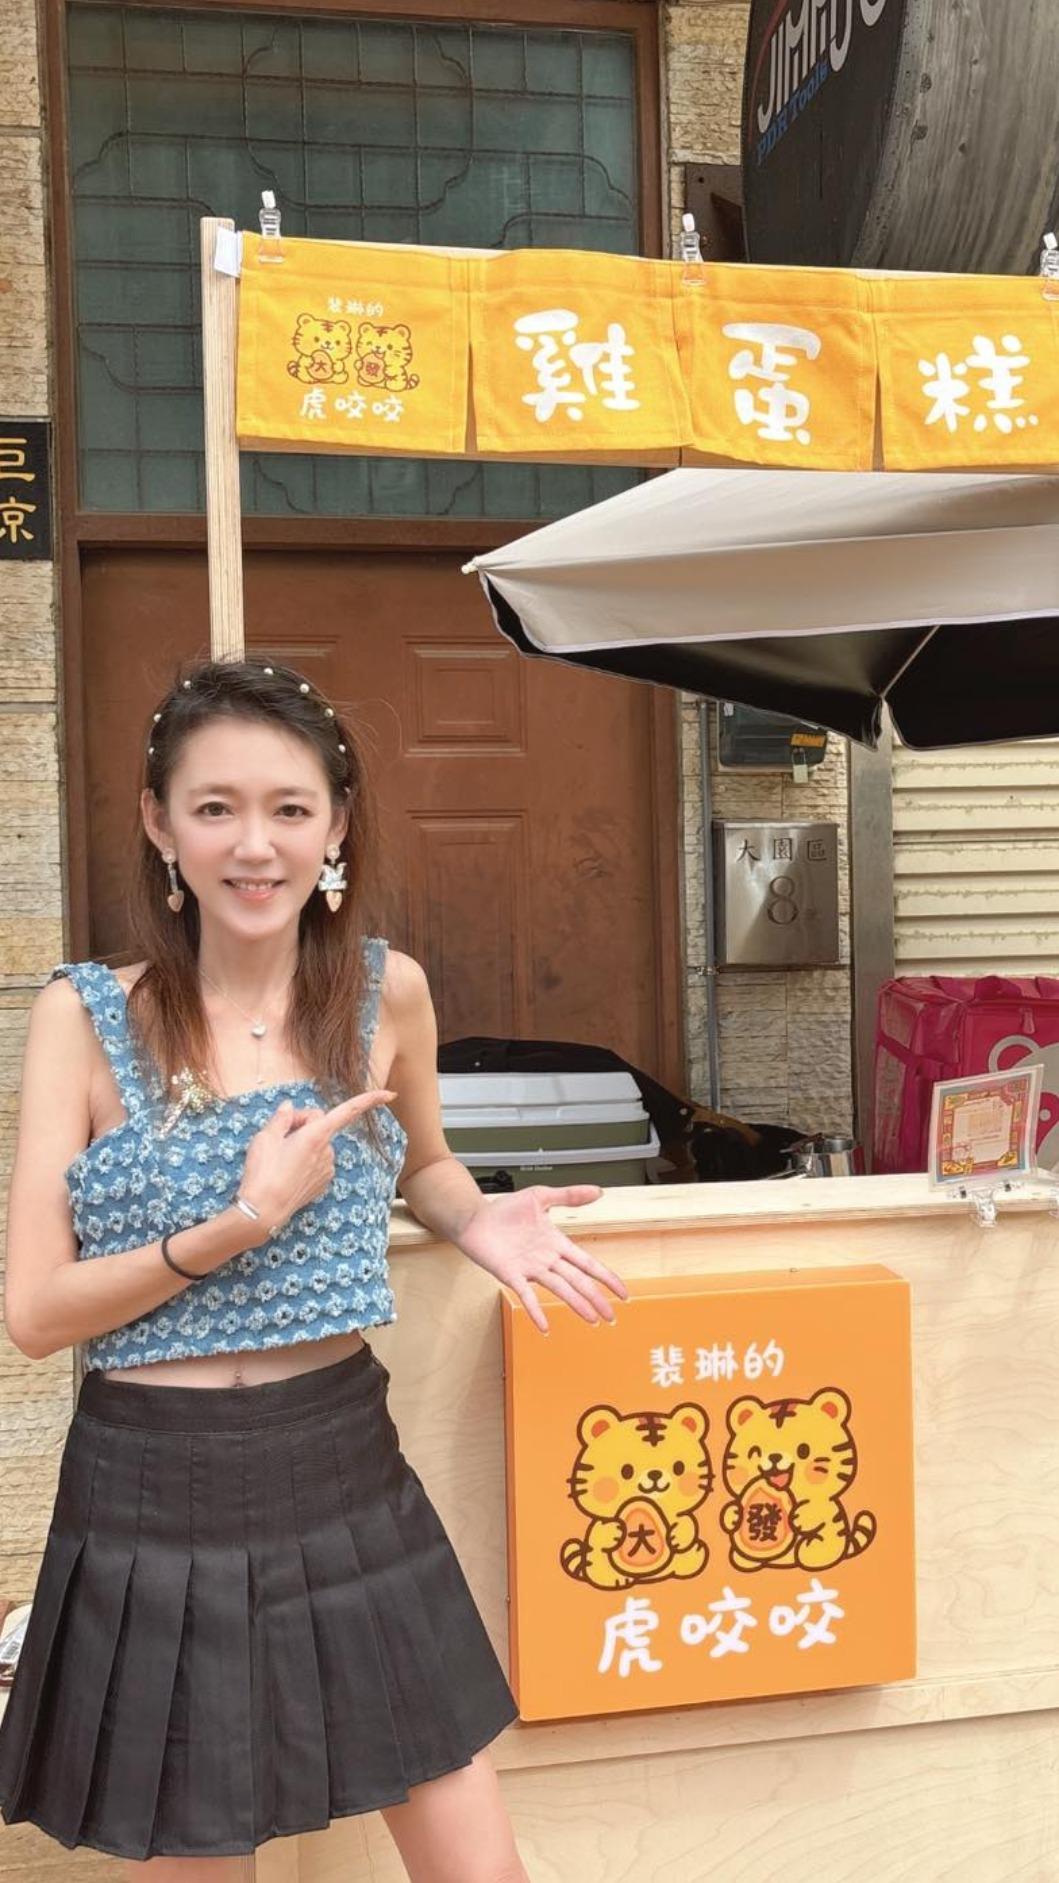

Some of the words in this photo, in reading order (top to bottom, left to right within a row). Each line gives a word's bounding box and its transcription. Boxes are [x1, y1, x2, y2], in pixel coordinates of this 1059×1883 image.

[300, 387, 405, 422] 虎咬咬
[736, 838, 828, 862] 大園區
[766, 876, 799, 925] 8
[649, 1338, 785, 1388] 裴琳的
[628, 1524, 656, 1557] 大
[747, 1502, 783, 1542] 發
[597, 1577, 846, 1678] 虎咬咬
